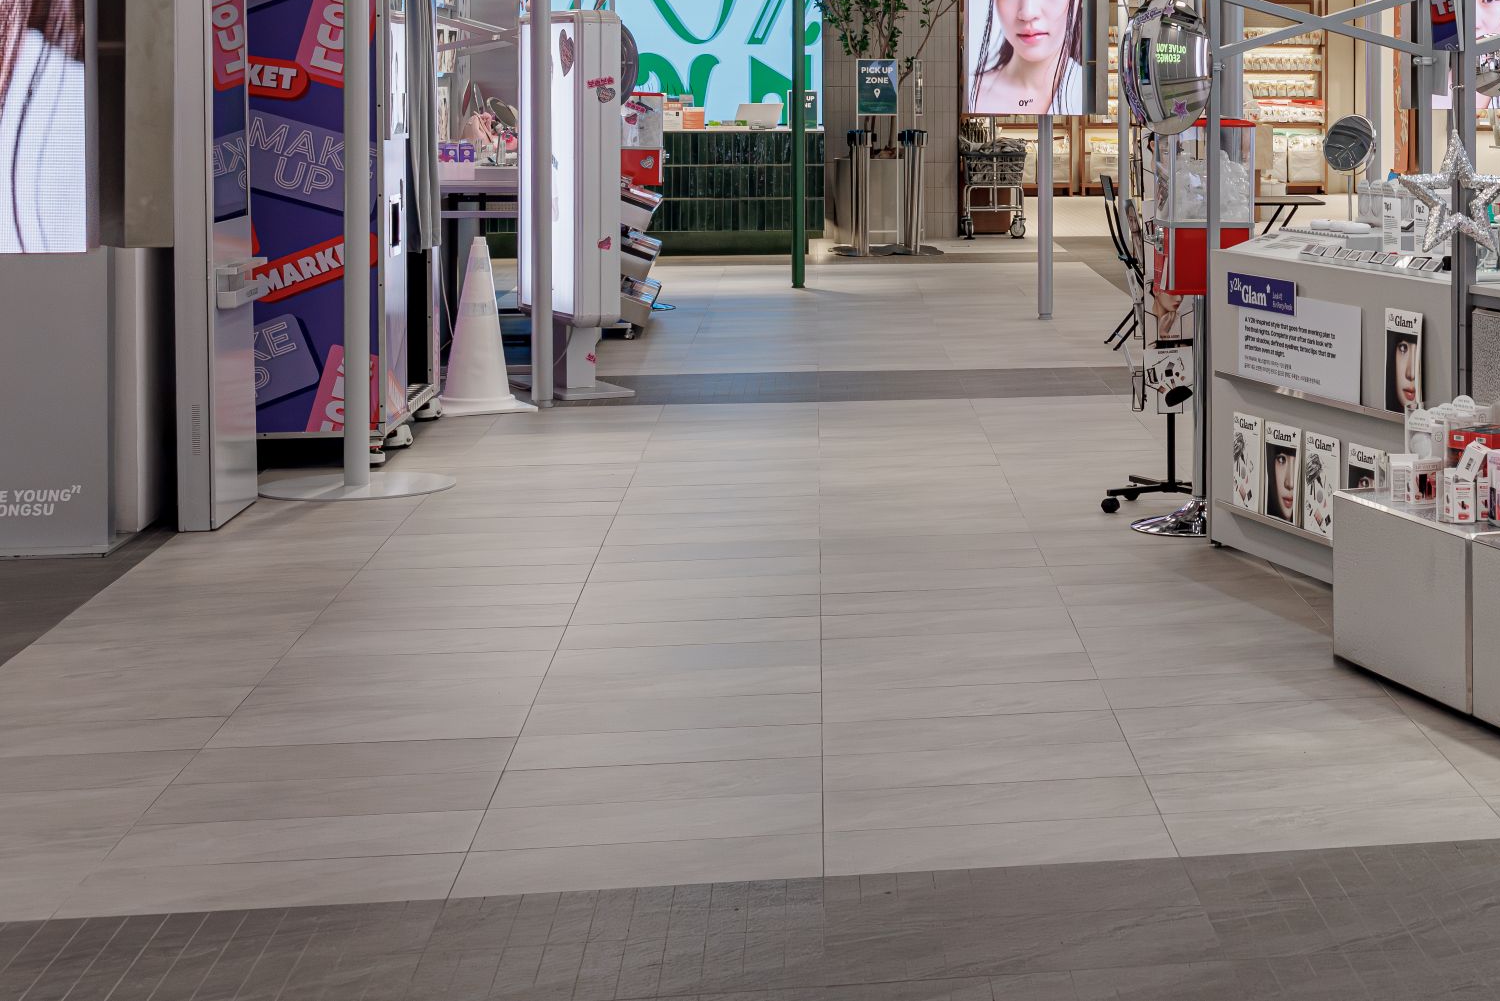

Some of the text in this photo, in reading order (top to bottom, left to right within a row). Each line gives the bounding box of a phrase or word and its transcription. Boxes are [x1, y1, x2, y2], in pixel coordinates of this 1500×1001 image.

[861, 66, 881, 74] PICK
[274, 156, 334, 195] UP
[1241, 284, 1268, 307] Glam
[1394, 315, 1414, 329] Glam
[1239, 418, 1254, 431] Glam
[1273, 429, 1292, 442] Glam
[1314, 438, 1333, 452] Glam
[1356, 450, 1375, 465] Glam
[14, 489, 72, 503] YOUNG
[0, 503, 55, 517] ONGSU
